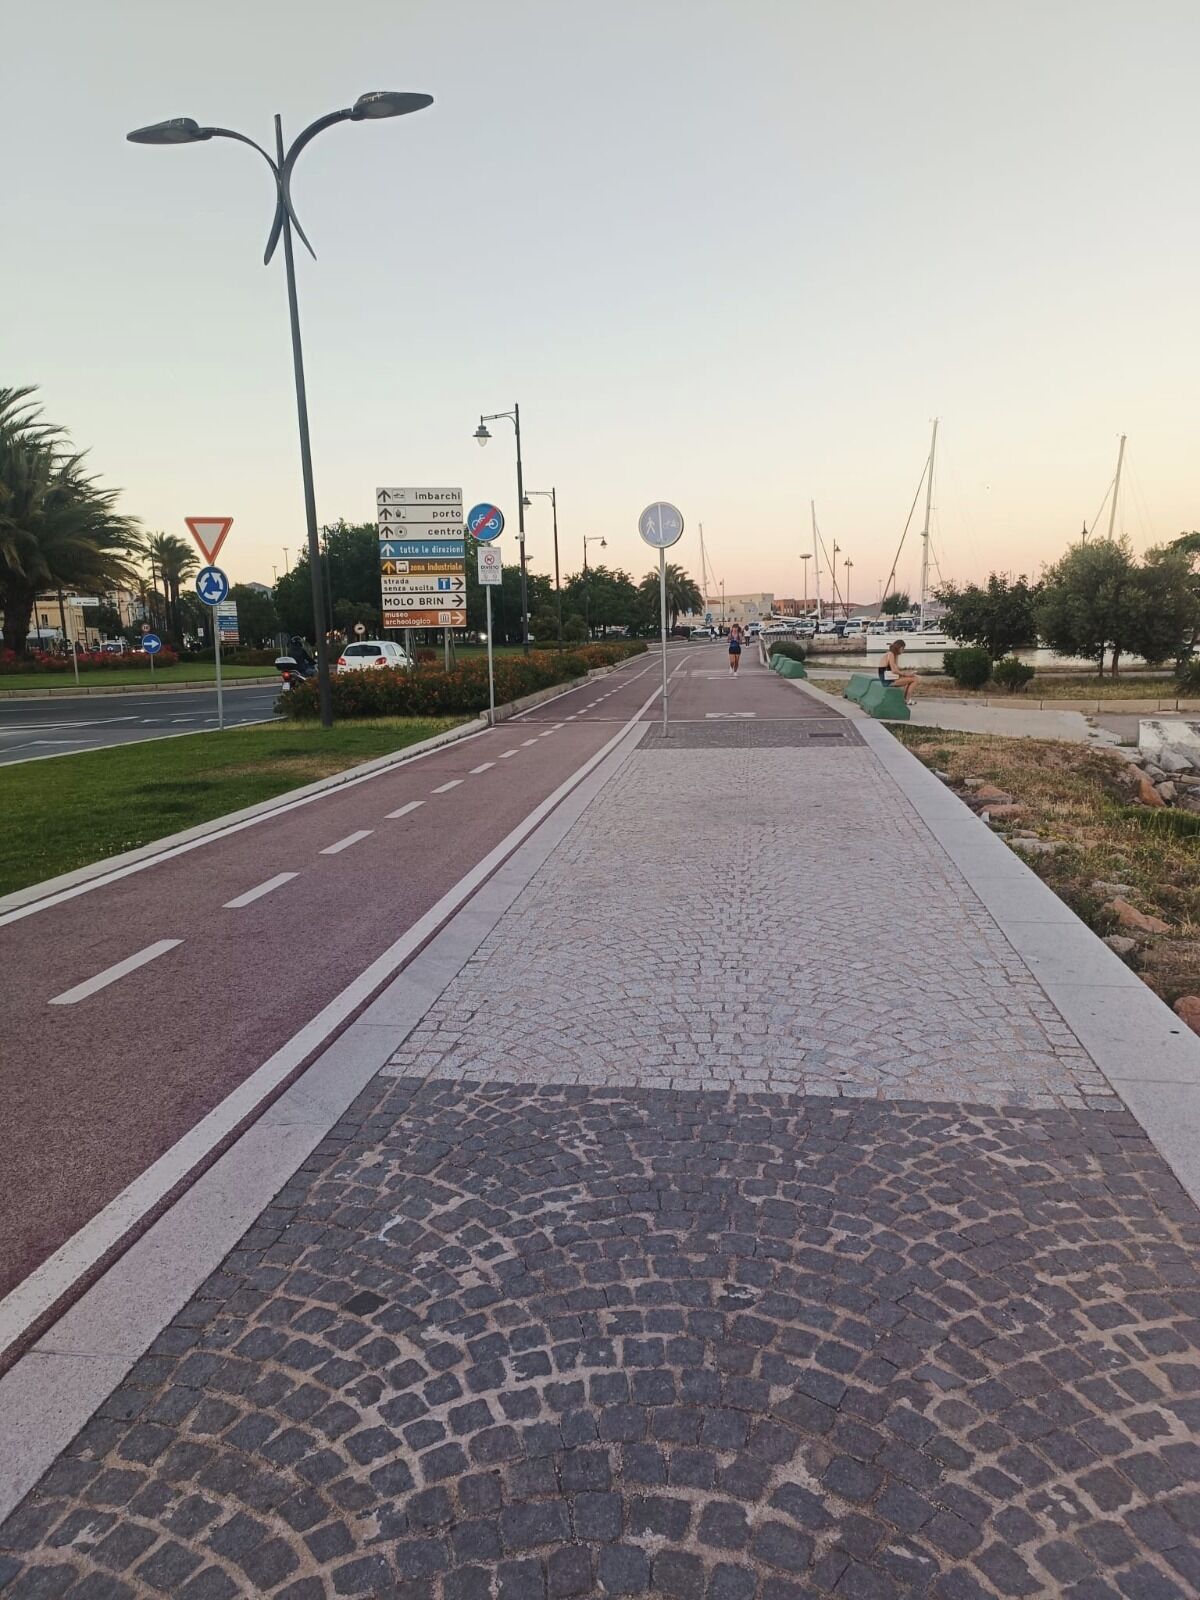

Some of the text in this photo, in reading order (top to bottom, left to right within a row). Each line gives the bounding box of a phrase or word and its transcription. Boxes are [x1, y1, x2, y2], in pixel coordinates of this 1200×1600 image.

[415, 492, 461, 500] imbarchi
[432, 510, 462, 519] porto
[427, 528, 462, 536] centro
[400, 545, 463, 554] tutte le direzioni
[427, 562, 463, 571] industriale
[384, 597, 444, 606] MOLO BRIN
[385, 618, 431, 626] archeologico
